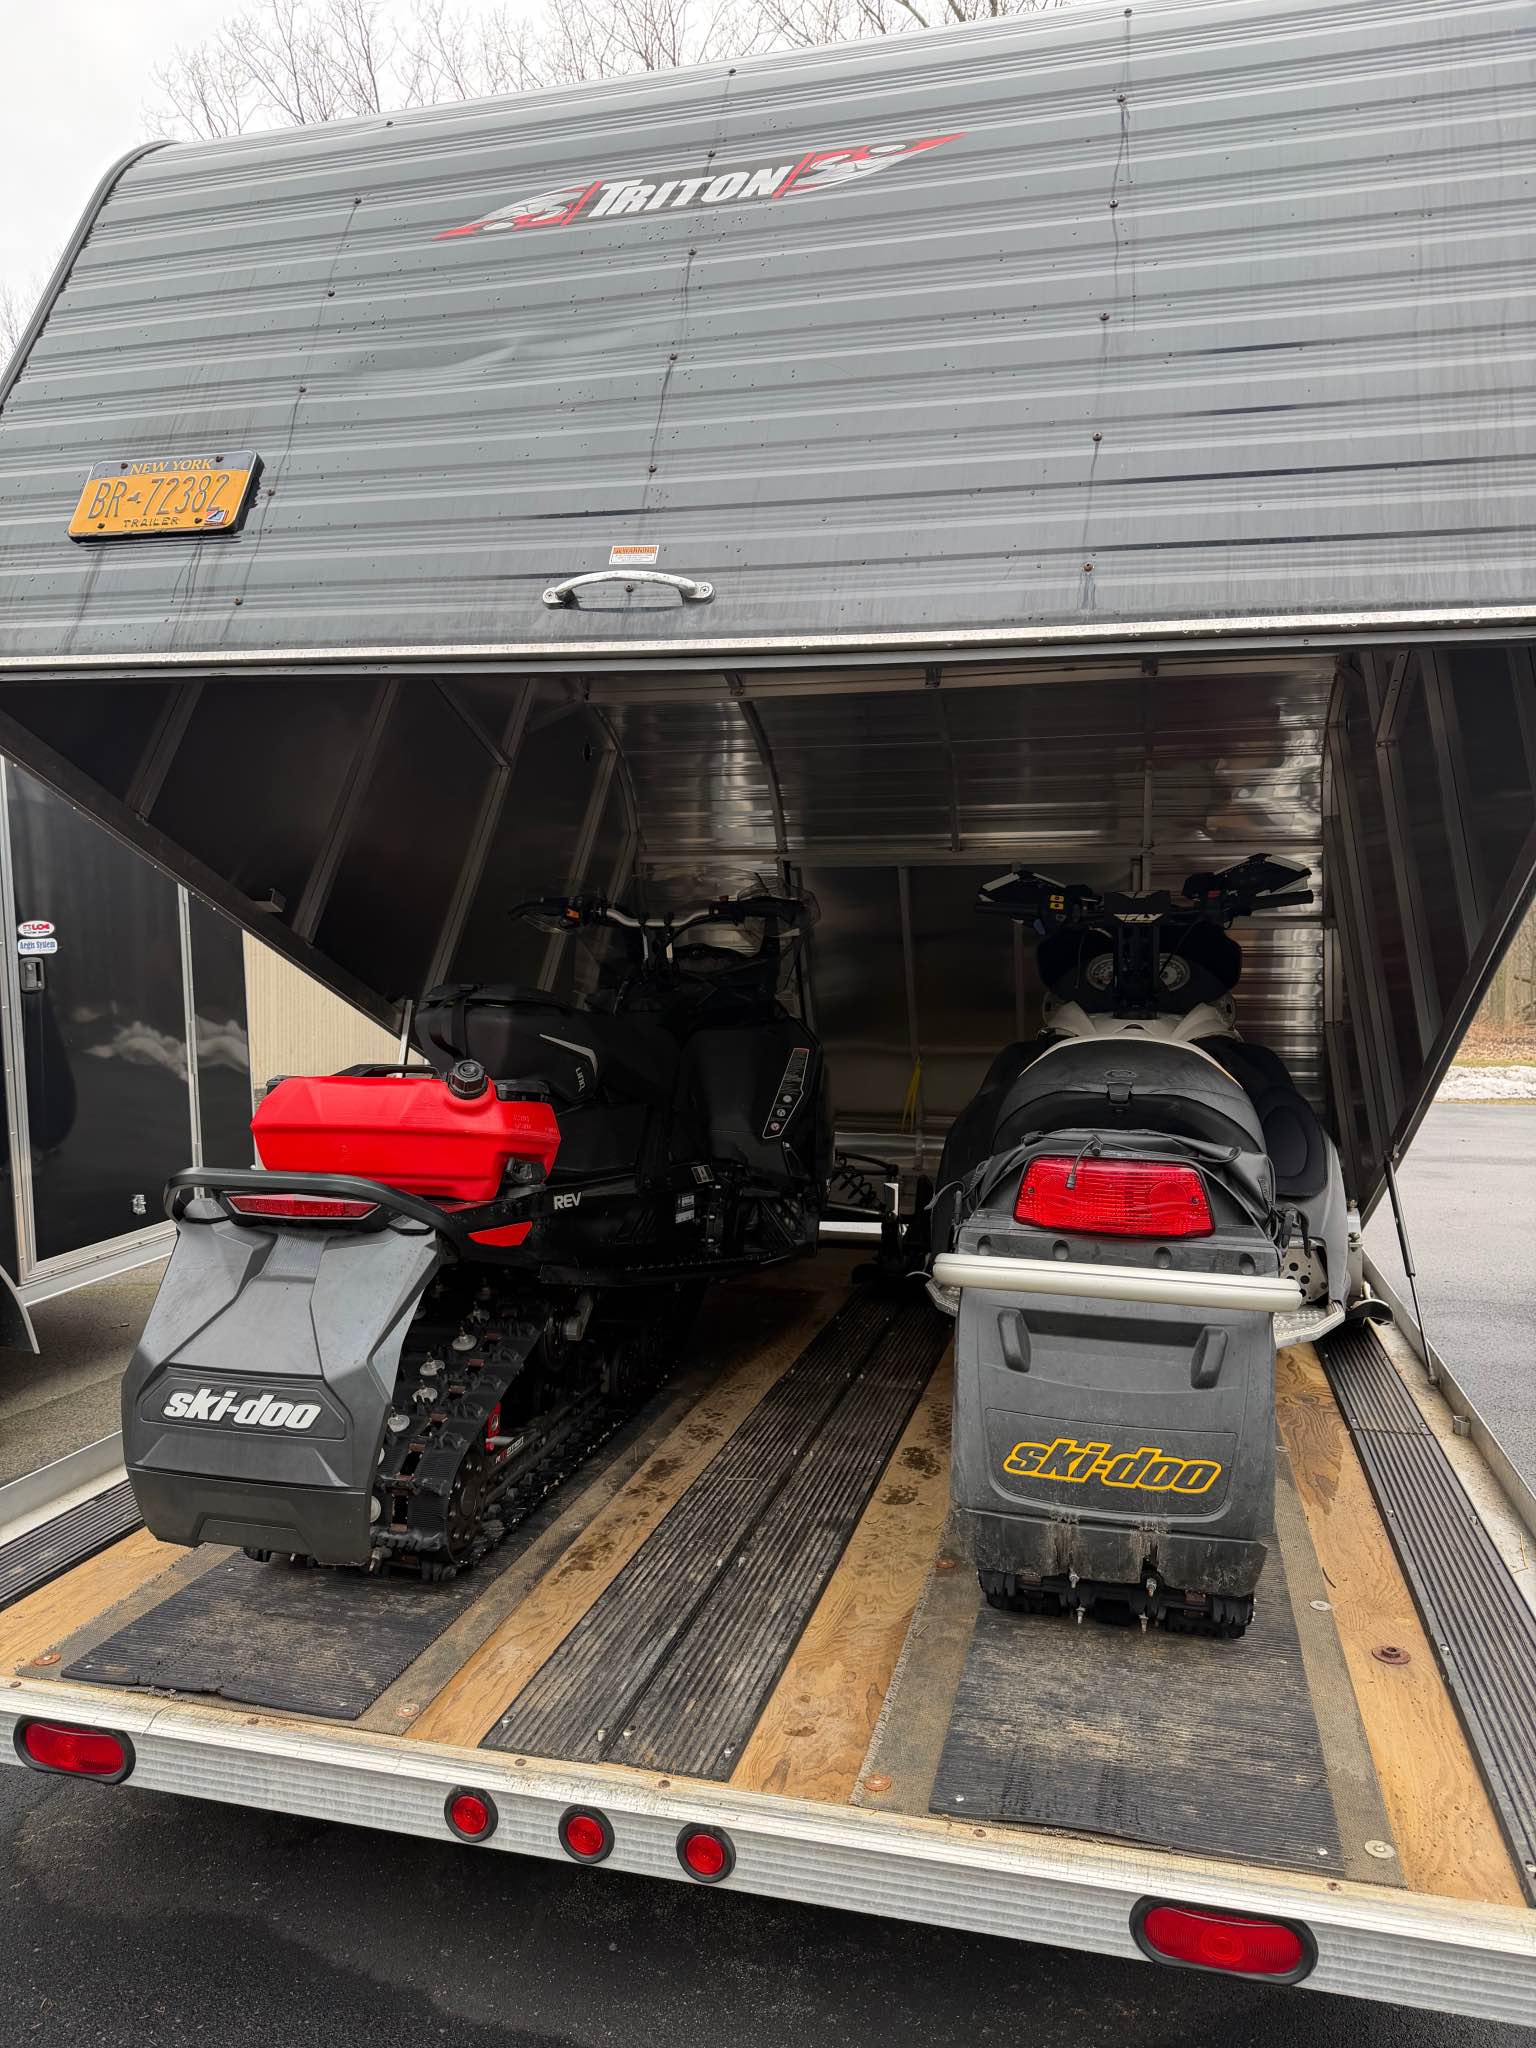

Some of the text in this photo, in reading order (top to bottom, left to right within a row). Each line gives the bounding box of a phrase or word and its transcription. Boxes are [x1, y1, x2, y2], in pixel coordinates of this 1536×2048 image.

[588, 164, 795, 218] TRITON
[130, 457, 214, 475] NEW YORK
[123, 516, 180, 528] TRAILER
[19, 940, 56, 950] Aegis System
[553, 1191, 583, 1211] REV
[163, 1388, 322, 1429] ski-doo
[1003, 1437, 1222, 1494] ski-doo
